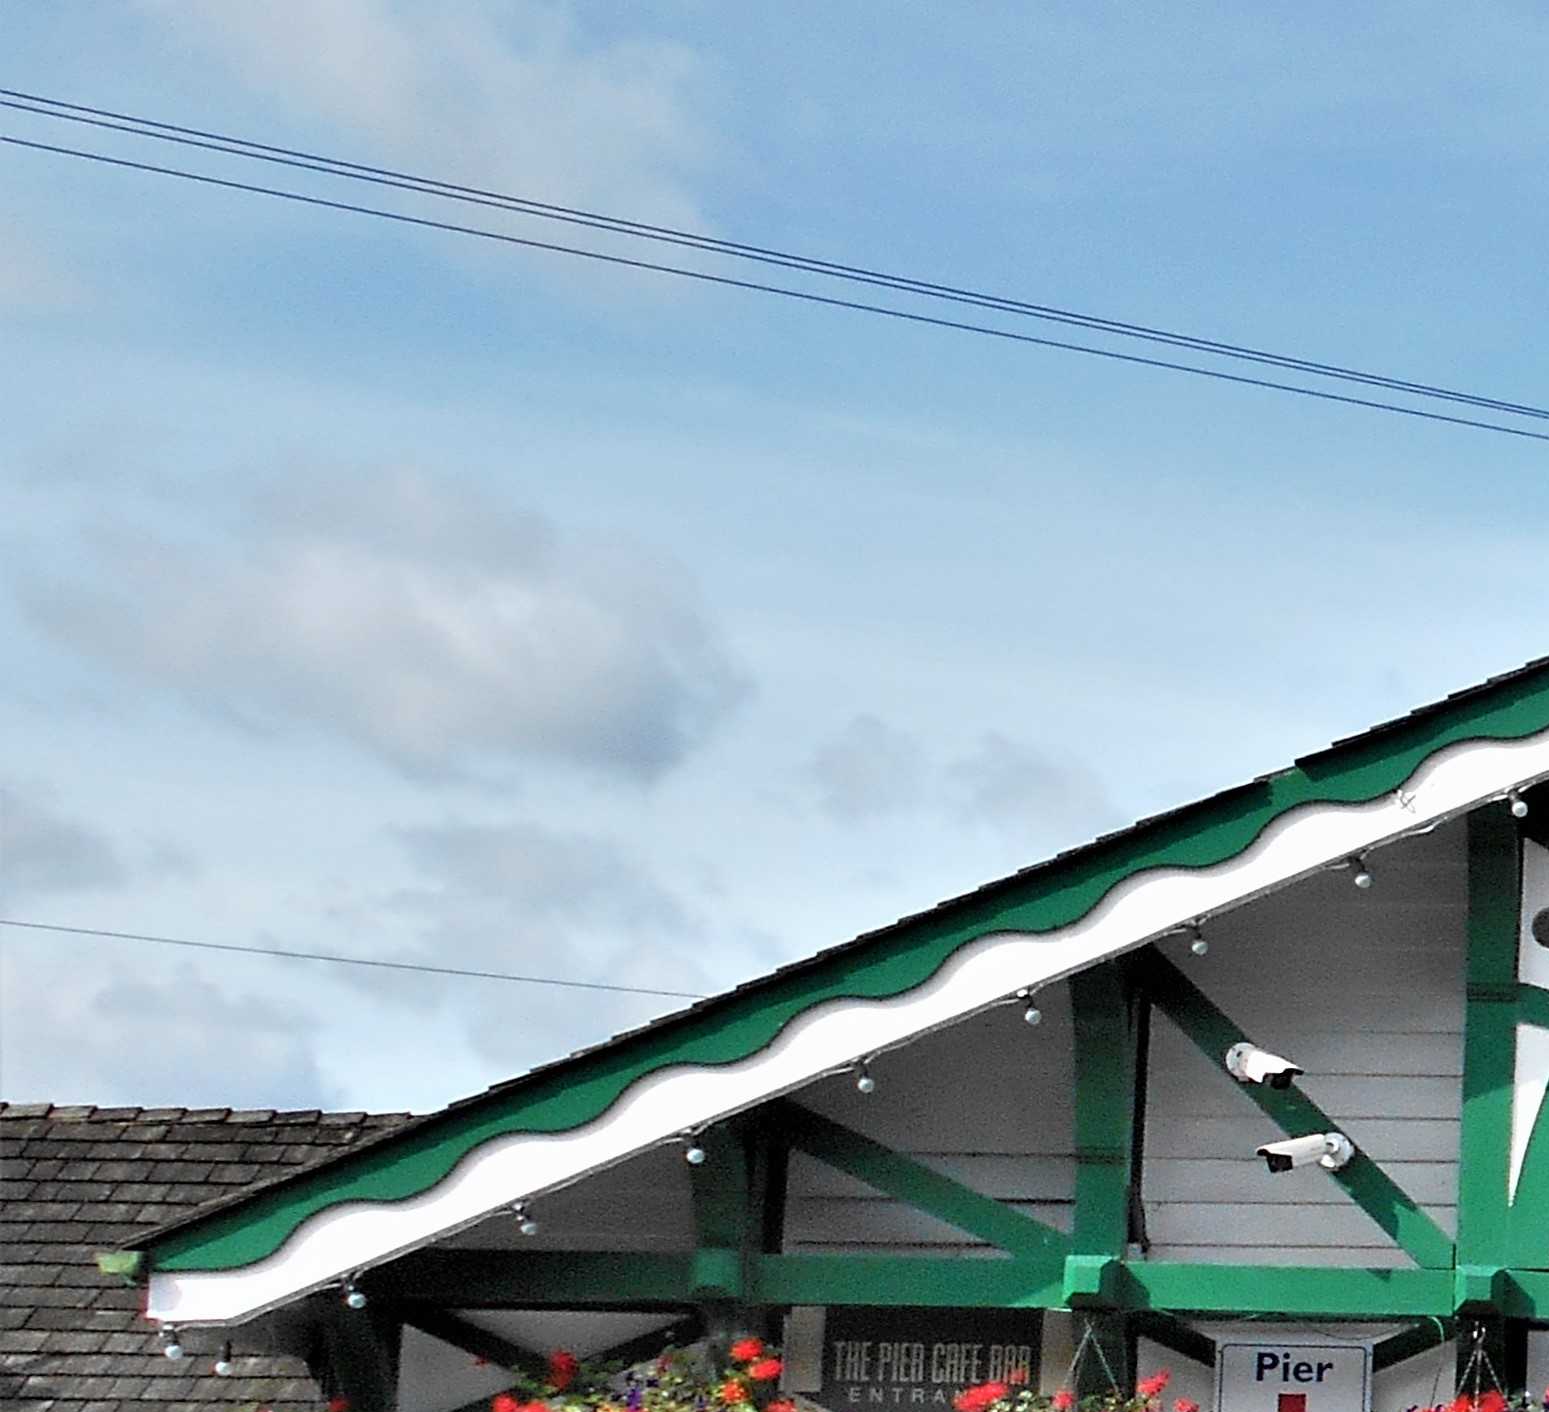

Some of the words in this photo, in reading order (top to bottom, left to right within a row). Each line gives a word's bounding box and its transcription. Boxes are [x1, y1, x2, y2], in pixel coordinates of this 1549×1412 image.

[834, 1341, 871, 1381] THE
[879, 1342, 924, 1382] PIER
[932, 1343, 982, 1383] CAFE
[1256, 1352, 1333, 1382] Pier
[850, 1387, 960, 1404] ENTRA
